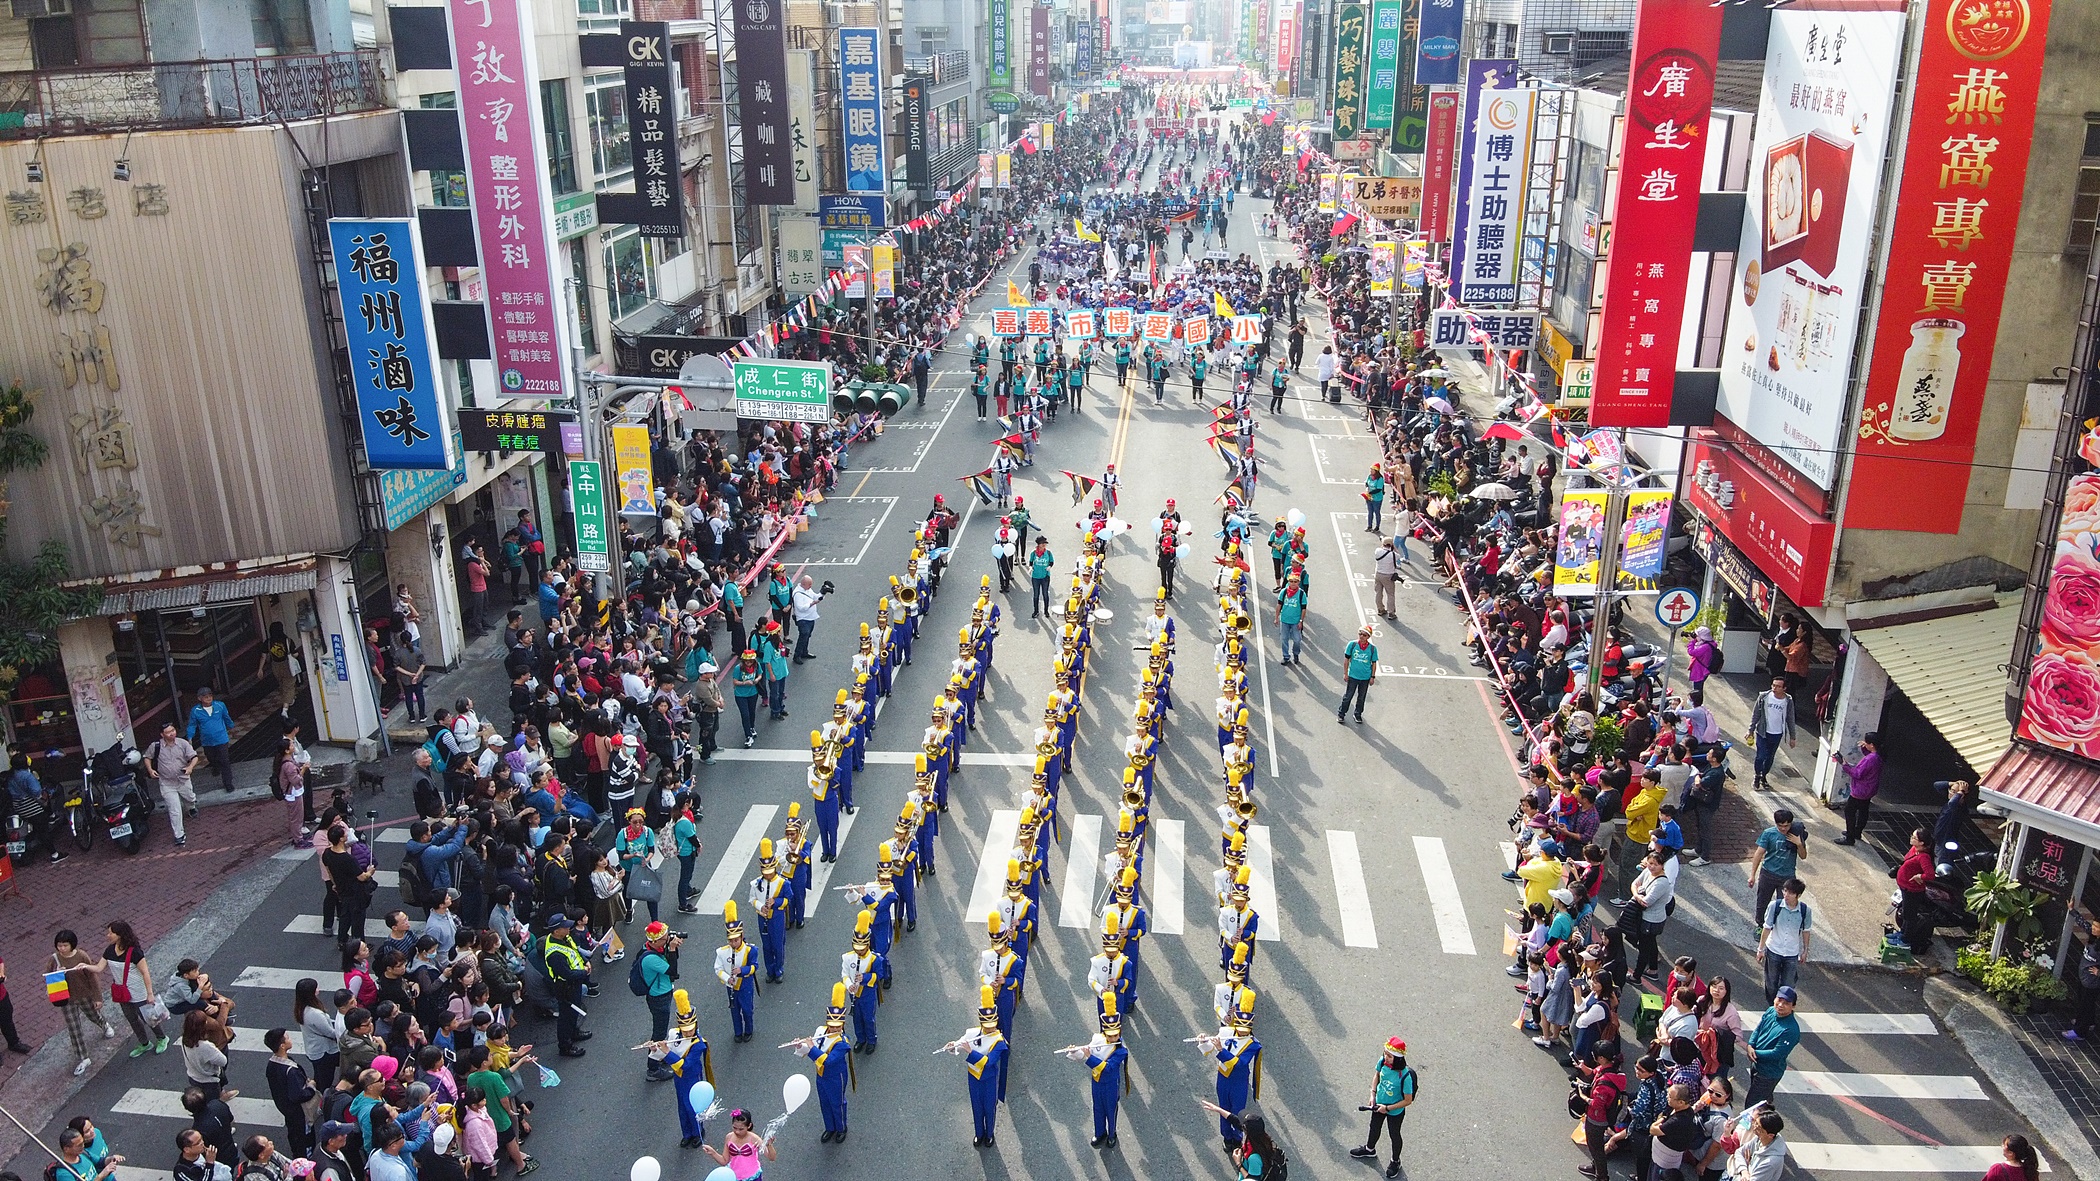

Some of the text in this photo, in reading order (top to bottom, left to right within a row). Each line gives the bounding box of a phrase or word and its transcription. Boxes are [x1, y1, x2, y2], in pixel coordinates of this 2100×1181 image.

[994, 0, 1005, 63] 小兒科診所
[1281, 22, 1290, 55] 新光銀行
[628, 36, 662, 60] GK
[1374, 8, 1398, 89] 麗嬰房
[1336, 16, 1363, 131] 巧藝珠寶
[844, 35, 879, 172] 嘉基眼鏡
[1790, 82, 1847, 117] 最好的燕窩
[1638, 62, 1694, 201] 廣生堂
[636, 86, 670, 208] 精品髮藝
[834, 197, 862, 206] HOYA
[1914, 68, 2009, 313] 燕窩專賣
[490, 155, 530, 269] 整形外科
[1474, 134, 1514, 280] 博士助聽器
[641, 224, 680, 234] 05-2255131
[501, 291, 546, 306] 整形手術
[504, 311, 537, 325] 微整形
[995, 308, 1258, 346] 嘉義市博愛國小
[1435, 315, 1534, 346] 助聽器
[1634, 263, 1665, 383] 燕窩專賣
[506, 331, 550, 345] 醫學美容
[508, 349, 553, 364] 雷射美容
[650, 348, 679, 368] GK
[525, 379, 560, 392] 2222188
[743, 367, 818, 389] 成仁街
[747, 386, 815, 399] Chengren St.
[485, 412, 546, 430] 皮膚腫瘤
[496, 434, 541, 450] 青春痘
[455, 474, 464, 483] 4F
[578, 479, 599, 539] 中山路
[579, 538, 605, 546] Zhongshan
[1381, 664, 1448, 677] B170
[2036, 838, 2064, 883] 莉兒
